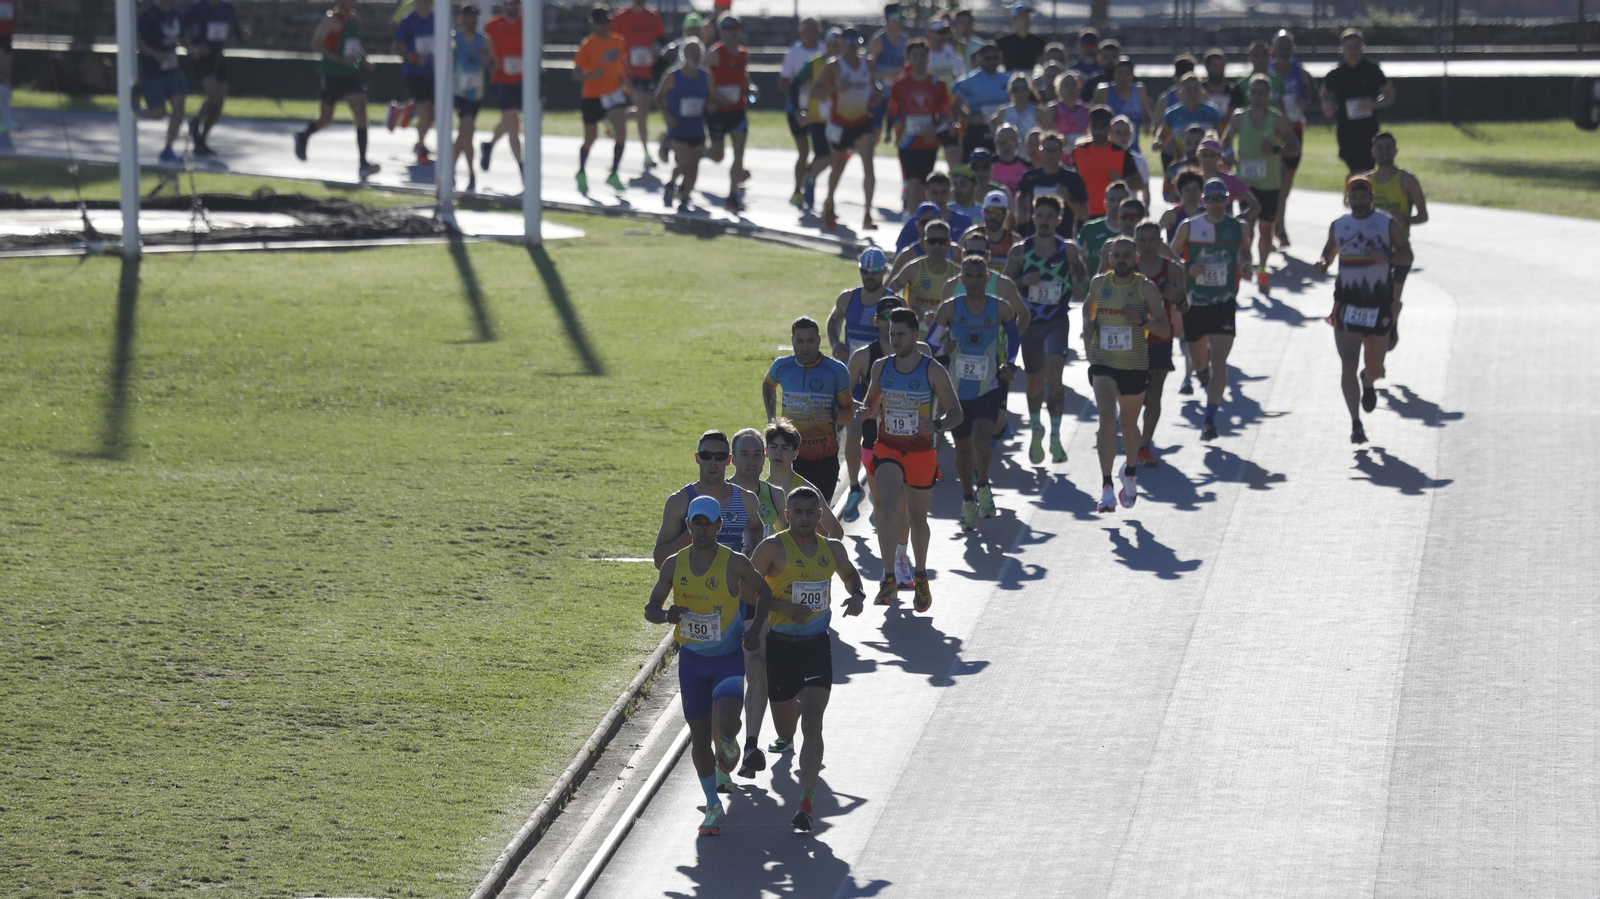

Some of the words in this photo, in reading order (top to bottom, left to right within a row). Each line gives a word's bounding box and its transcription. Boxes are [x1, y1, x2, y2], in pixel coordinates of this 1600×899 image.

[1108, 335, 1118, 345] 61
[964, 363, 975, 374] 82
[892, 419, 905, 429] 19
[800, 592, 821, 604] 209
[687, 622, 708, 635] 150
